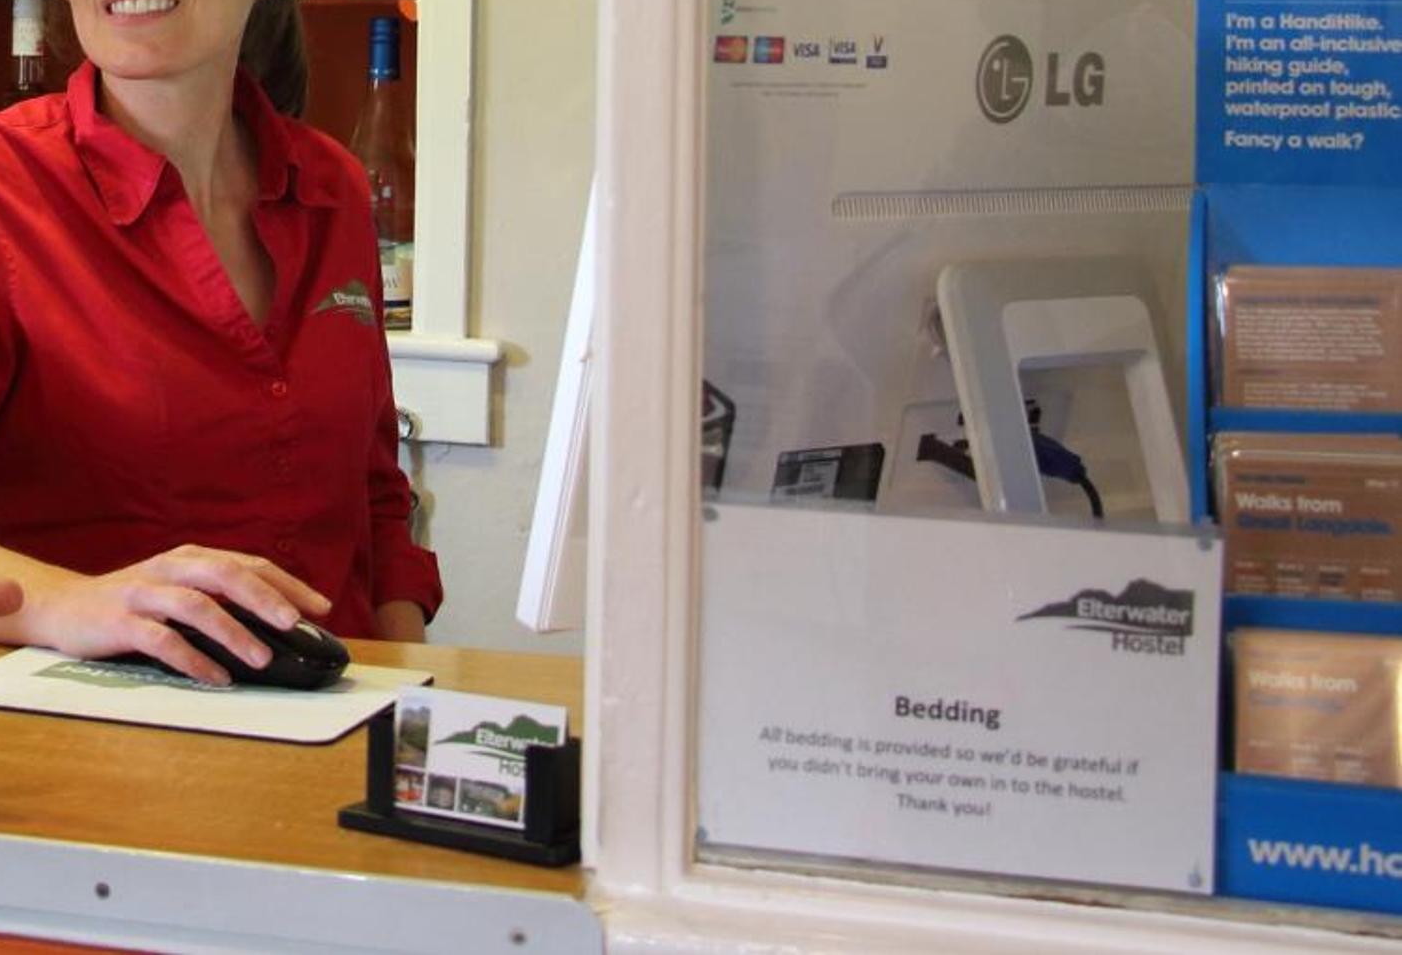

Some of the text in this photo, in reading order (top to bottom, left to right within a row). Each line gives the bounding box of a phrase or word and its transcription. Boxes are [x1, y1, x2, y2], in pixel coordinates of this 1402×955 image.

[1225, 12, 1255, 29] I'm
[1260, 16, 1274, 29] a
[1225, 35, 1254, 51] I'm
[1260, 38, 1285, 51] an
[1225, 57, 1349, 77] hiking guide,
[1045, 52, 1104, 107] LG
[1225, 79, 1392, 101] printed on tough,
[1225, 101, 1330, 119] waterproof
[1225, 131, 1364, 151] Fancy a walk?
[1077, 597, 1191, 626] Elterwater
[1111, 631, 1186, 656] Hostel
[894, 696, 1001, 730] Bedding
[759, 727, 1139, 775] All bedding is provided so we'd be grateful if
[768, 758, 798, 773] you
[802, 759, 852, 776] didn't
[857, 765, 901, 784] bring
[904, 772, 944, 785] your
[949, 775, 985, 788] own
[991, 774, 1006, 790] in
[1011, 779, 1030, 793] to
[1035, 781, 1063, 796] the
[897, 793, 992, 817] Thank you!
